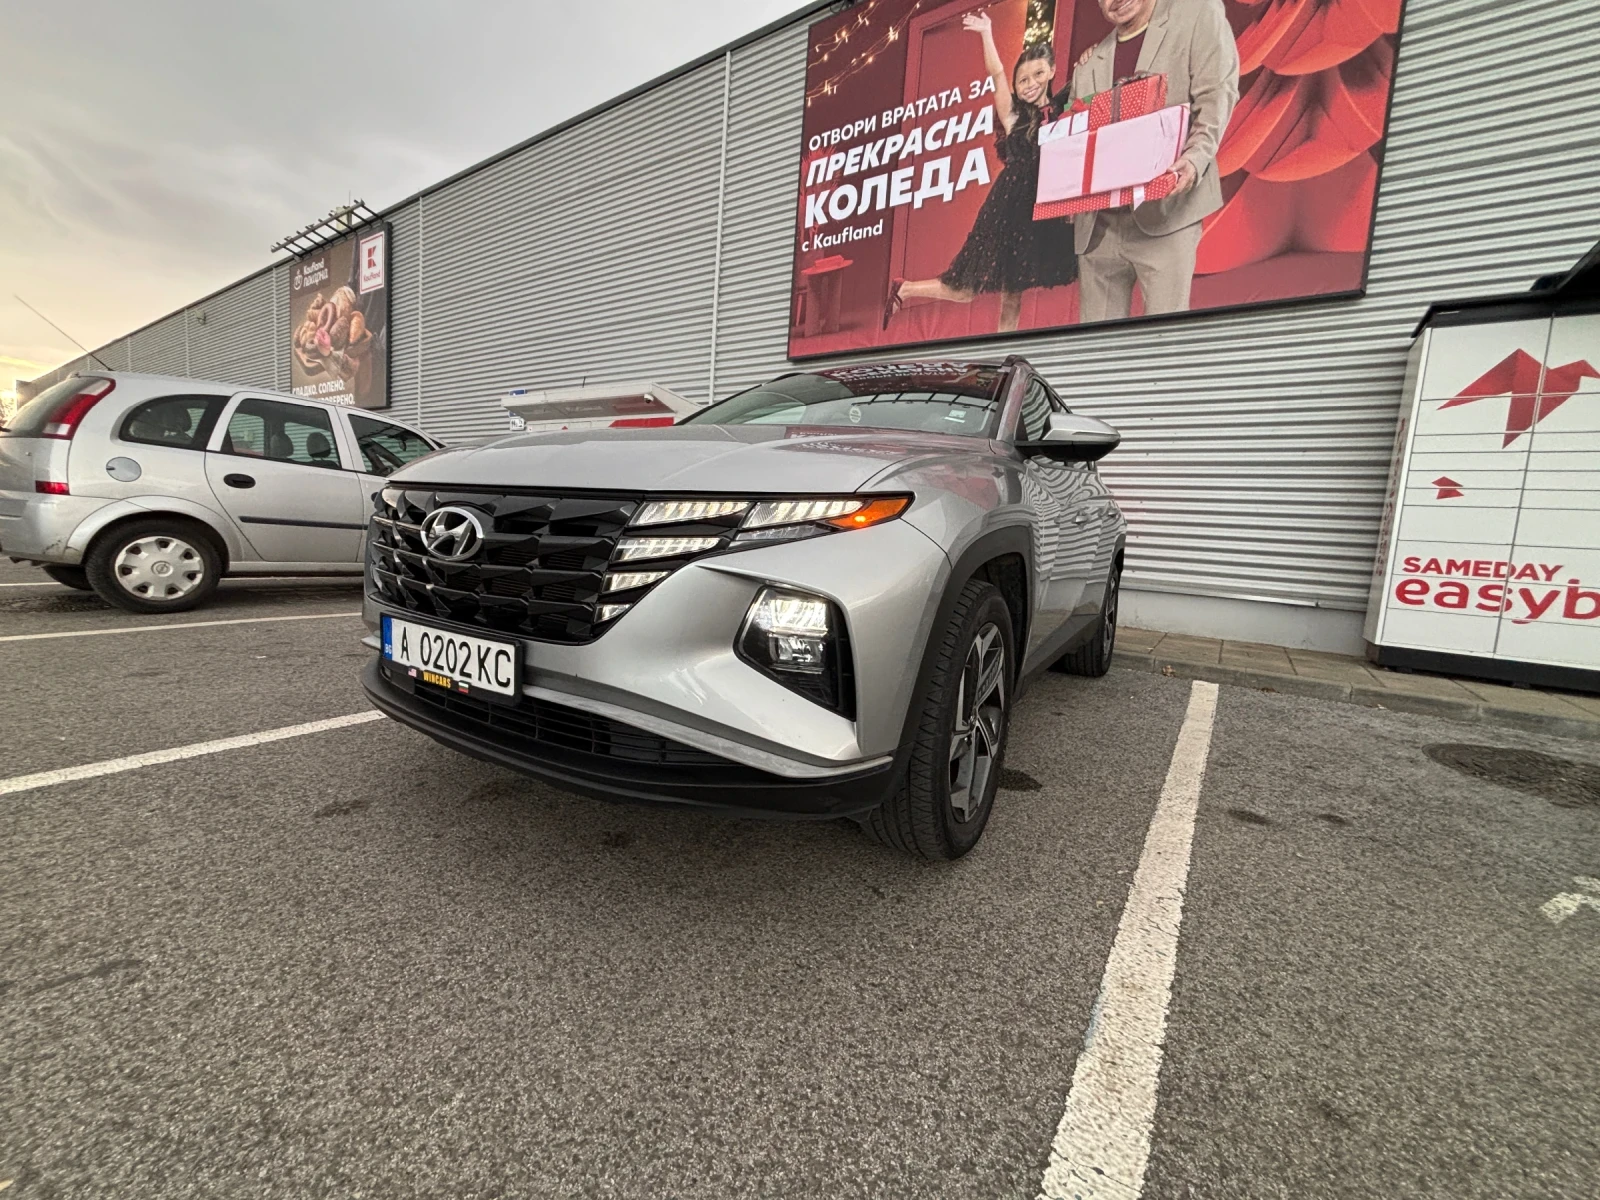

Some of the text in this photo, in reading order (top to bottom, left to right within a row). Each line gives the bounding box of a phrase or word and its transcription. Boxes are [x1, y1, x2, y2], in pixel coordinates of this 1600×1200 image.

[808, 75, 996, 151] ОТВОРИ ВРАТАТА ЗА
[805, 104, 994, 187] ПРЕКРАСНА
[804, 147, 991, 229] КОЛЕДА
[813, 219, 884, 250] Kaufland
[1402, 556, 1564, 582] SAMEDAY
[400, 626, 410, 662] A
